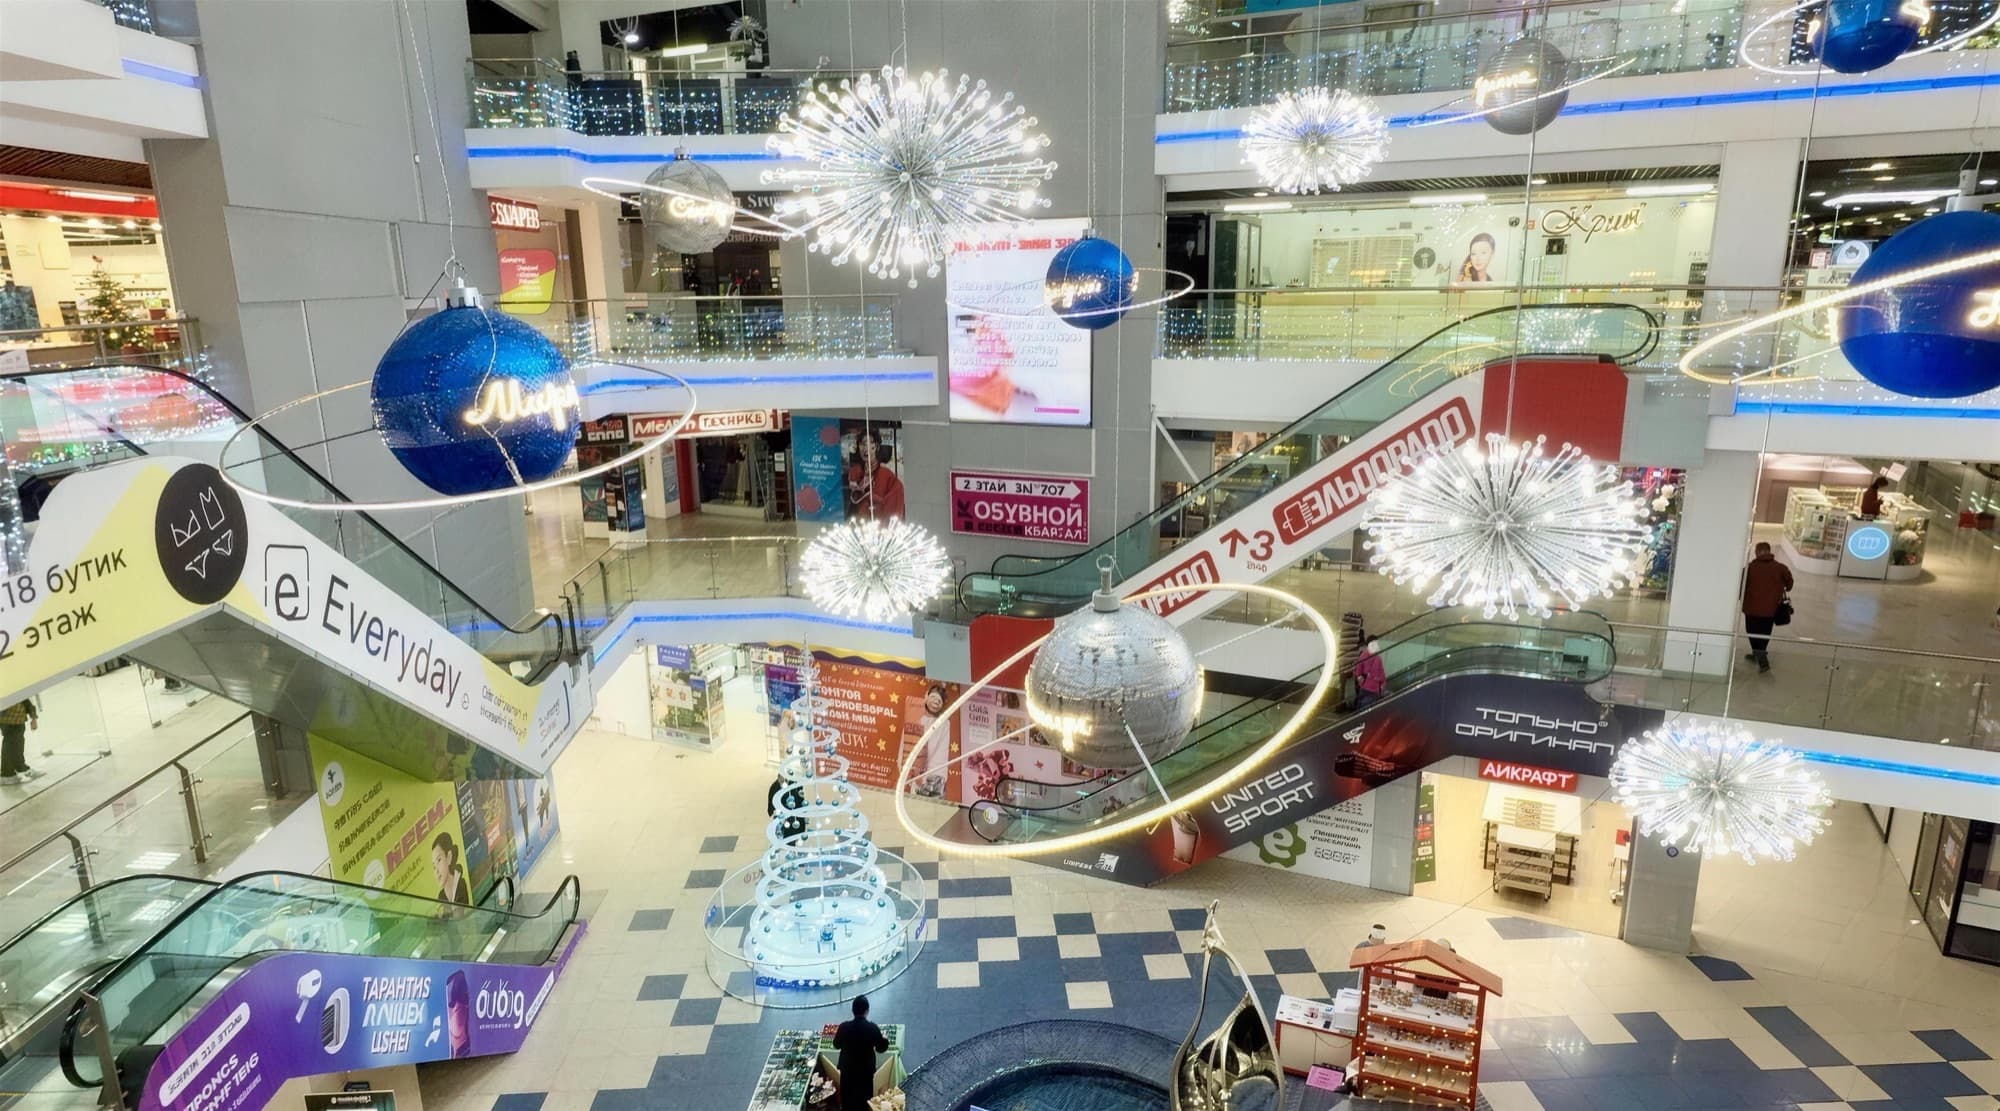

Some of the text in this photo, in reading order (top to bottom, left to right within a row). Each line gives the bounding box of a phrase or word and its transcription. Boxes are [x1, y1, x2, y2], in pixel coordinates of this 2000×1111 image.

[963, 479, 971, 490] 2
[1250, 530, 1275, 562] 3
[46, 548, 127, 594] бутик
[23, 602, 97, 649] этаж
[321, 574, 462, 708] Everyday
[1210, 763, 1305, 814] UNITED
[1223, 781, 1314, 834] SPORT
